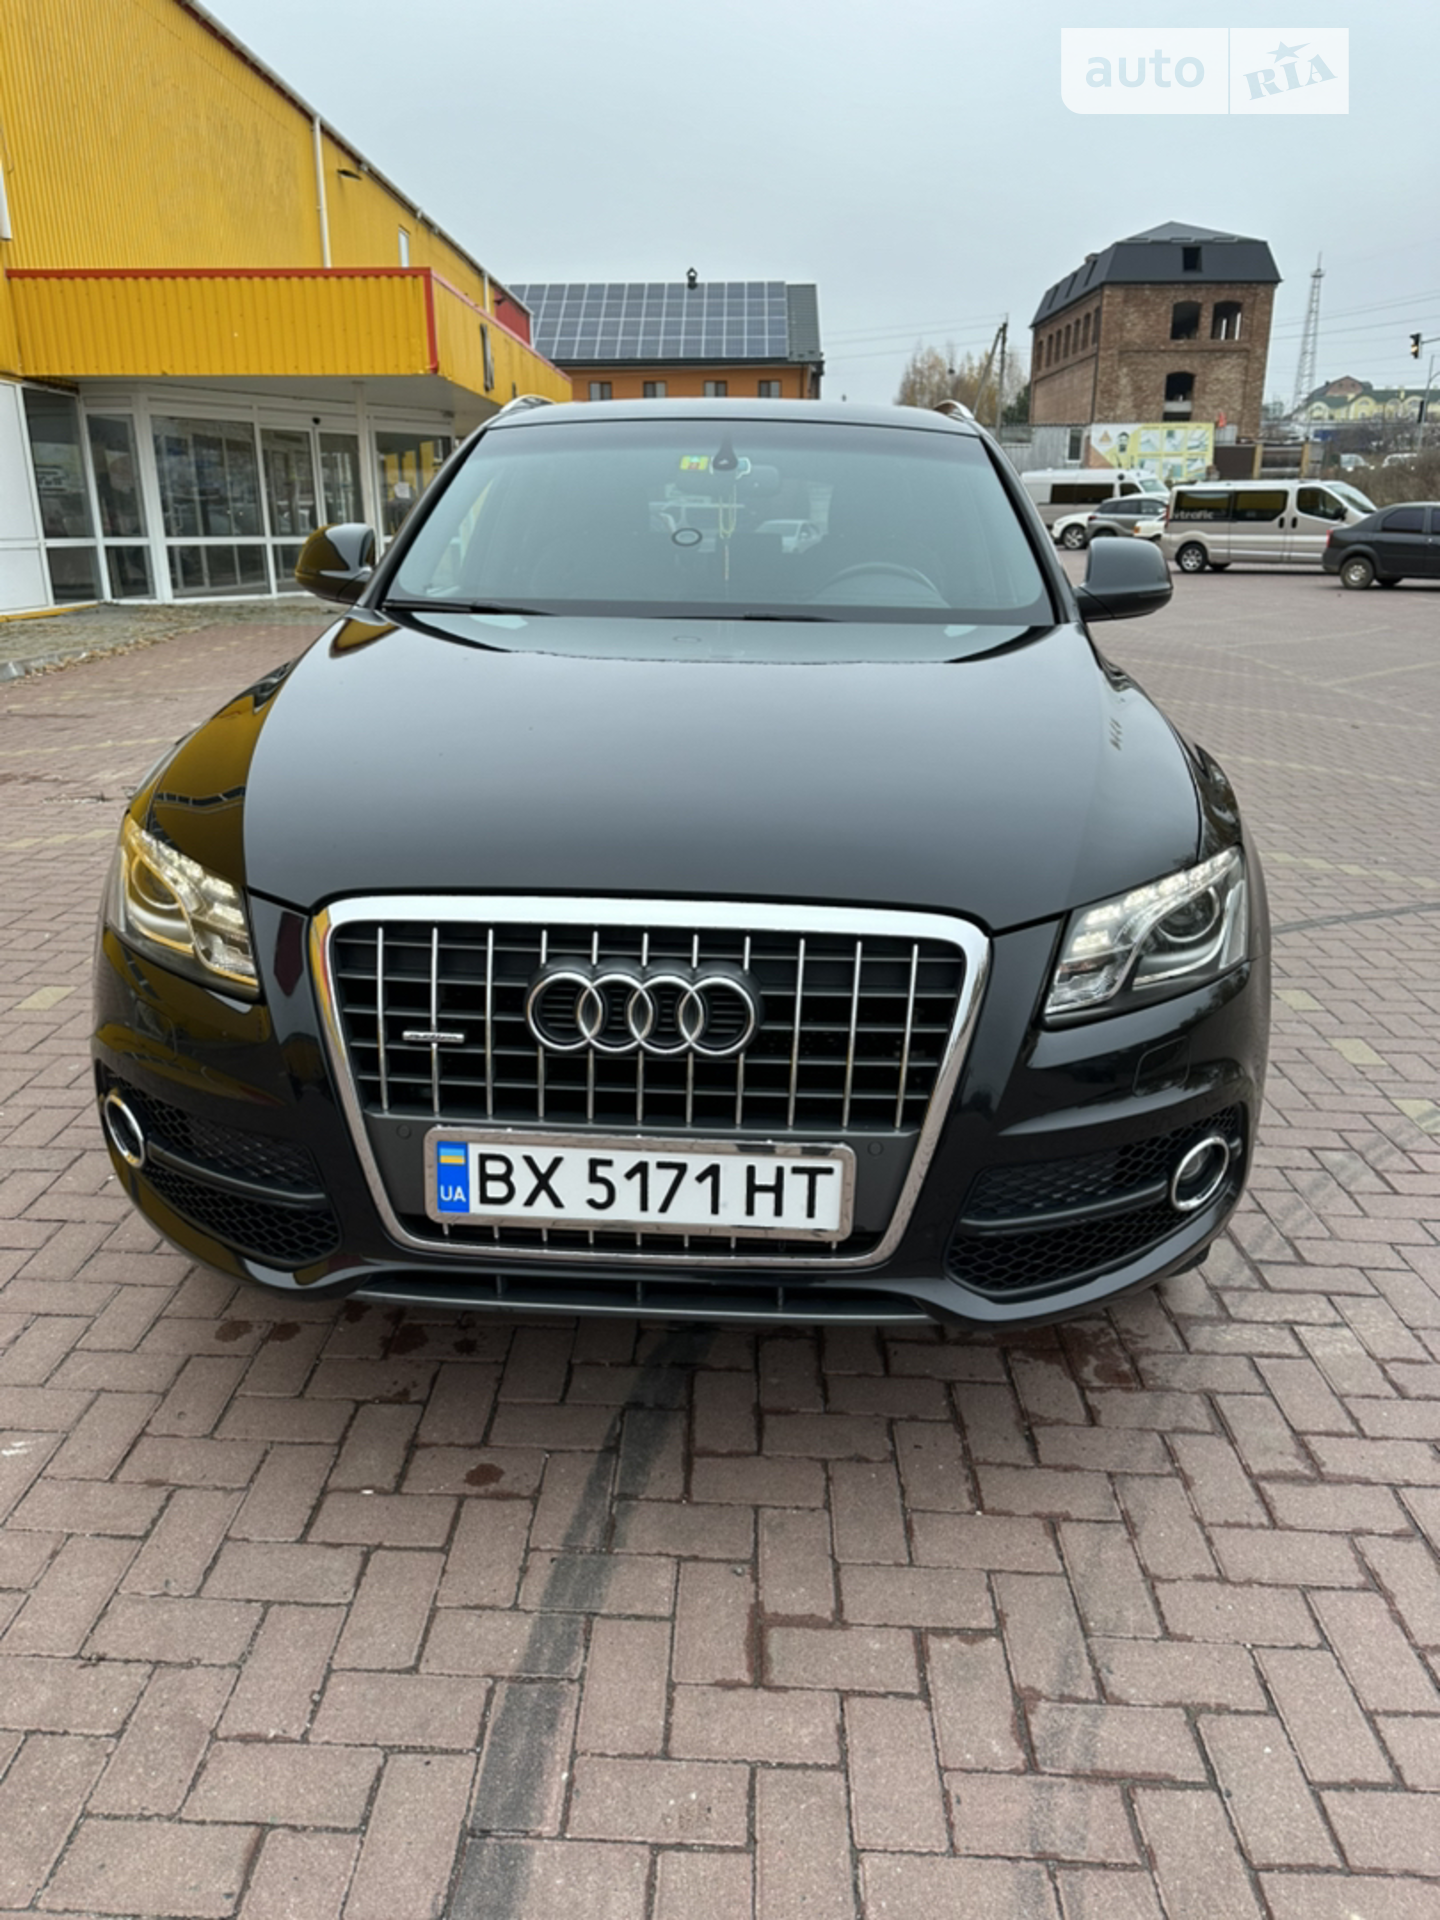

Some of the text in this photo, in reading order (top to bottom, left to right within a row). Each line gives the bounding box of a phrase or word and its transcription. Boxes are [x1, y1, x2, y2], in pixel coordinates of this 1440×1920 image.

[440, 1185, 467, 1203] UA
[478, 1152, 835, 1219] BX 5171 HT
